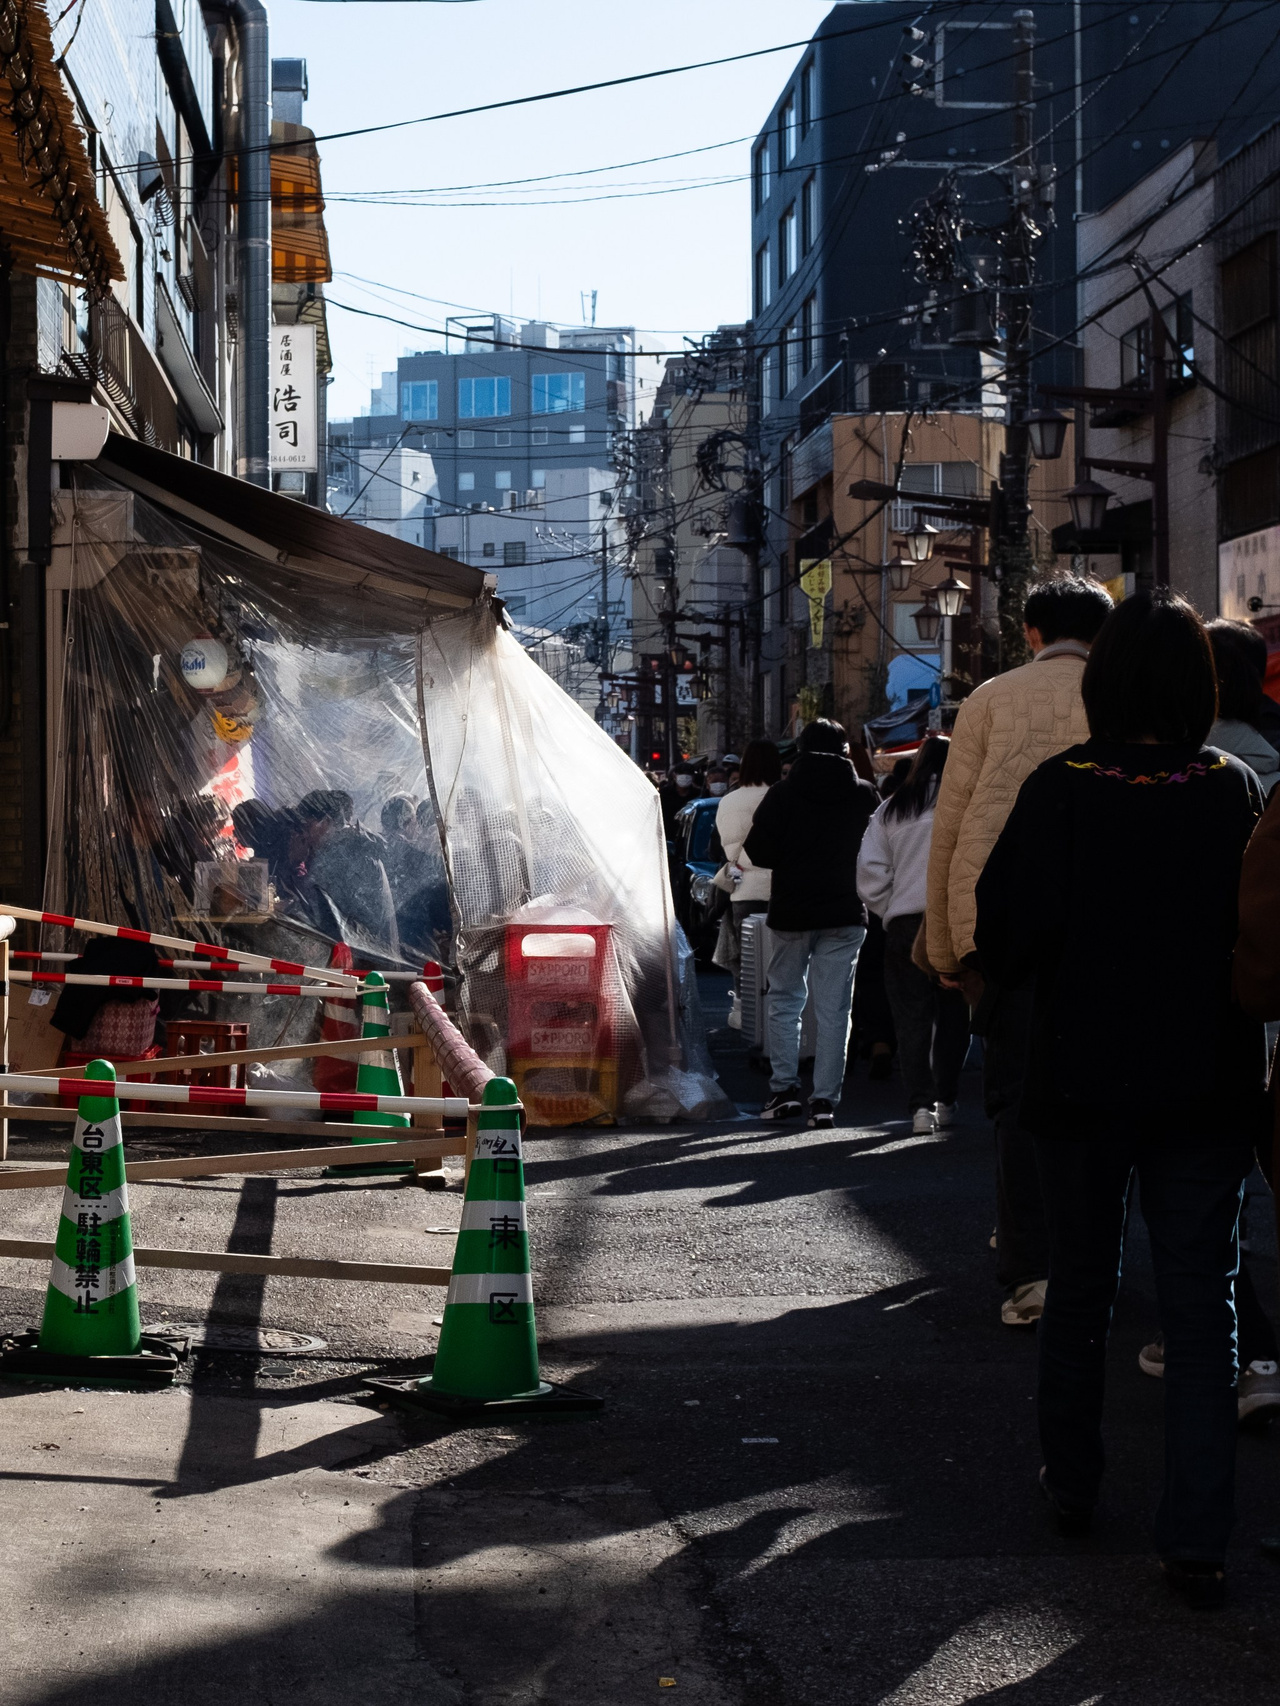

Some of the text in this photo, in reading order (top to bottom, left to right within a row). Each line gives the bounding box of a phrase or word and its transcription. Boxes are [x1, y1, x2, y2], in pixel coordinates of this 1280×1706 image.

[280, 334, 293, 376] 居酒屋
[273, 384, 302, 447] 浩司
[79, 1124, 104, 1200] 台東区
[73, 1212, 103, 1315] 駐輪禁止
[488, 1139, 521, 1325] 台東区
